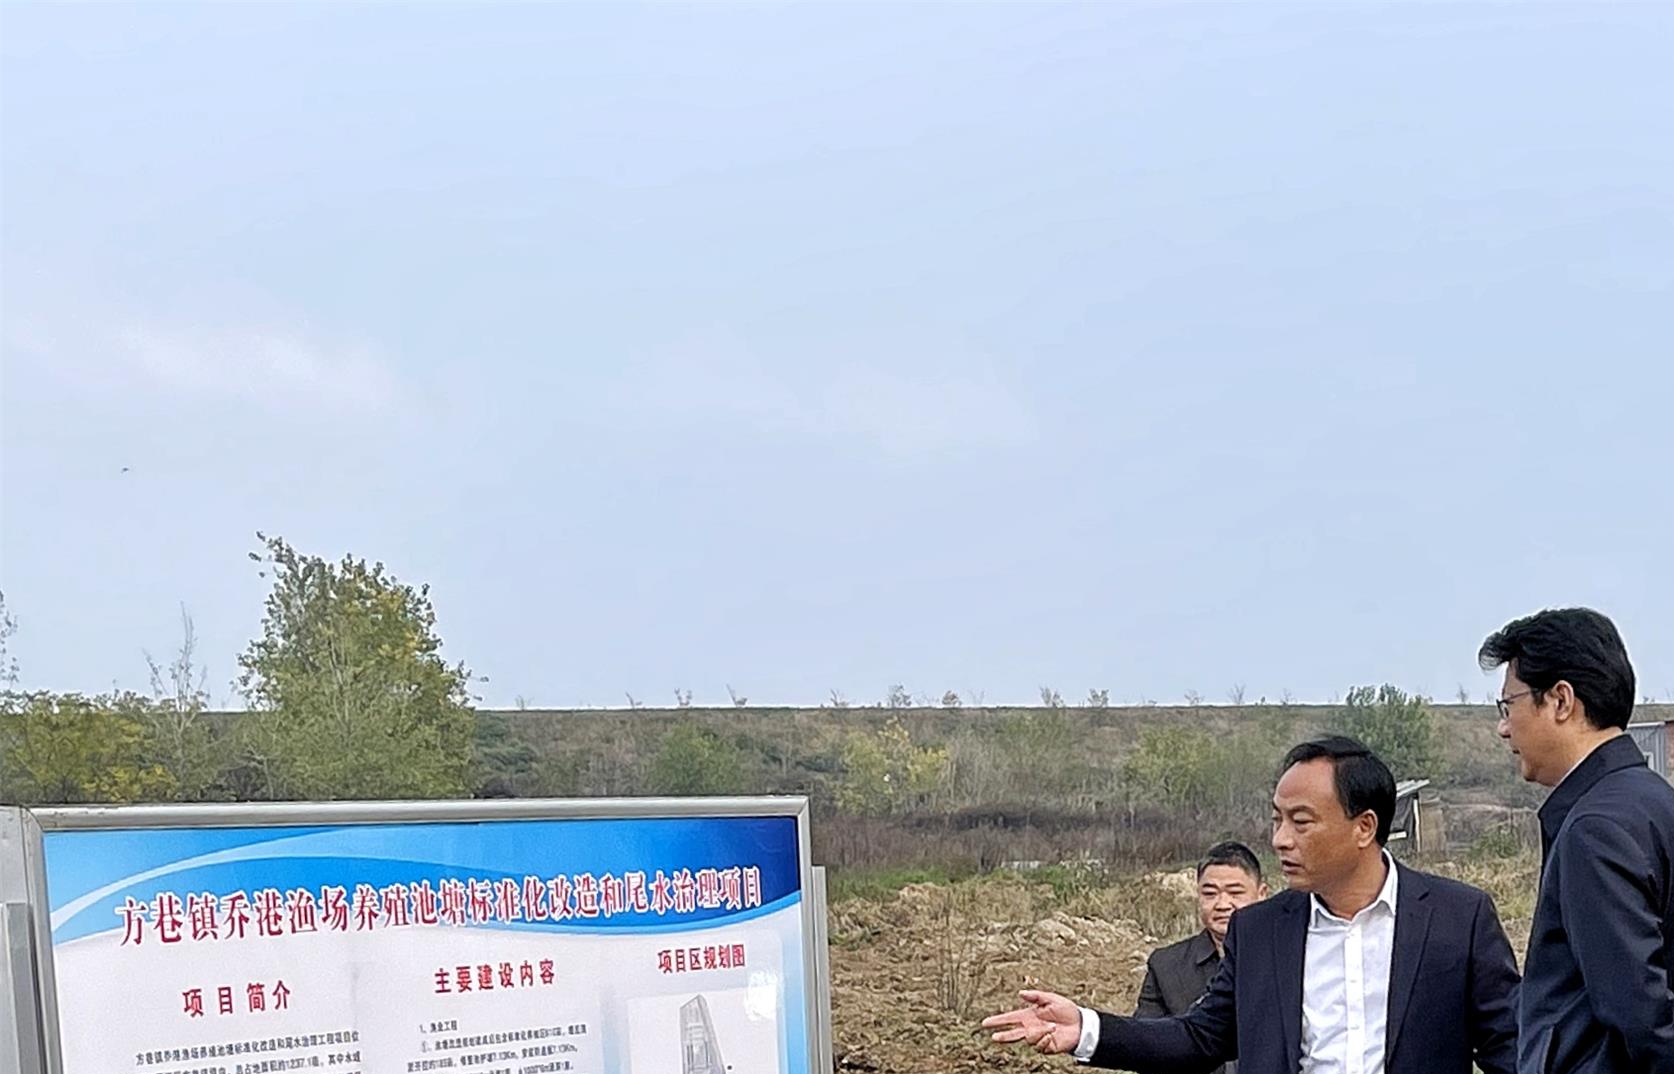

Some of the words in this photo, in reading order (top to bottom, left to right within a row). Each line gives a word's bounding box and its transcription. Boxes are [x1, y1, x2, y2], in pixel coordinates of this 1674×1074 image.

[117, 866, 762, 947] 方巷镇乔港渔场养殖池塘标准化改造和尾水治理项目
[657, 943, 744, 973] 项目区规划图
[434, 960, 555, 994] 主要建设内容
[182, 980, 291, 1018] 项目简介
